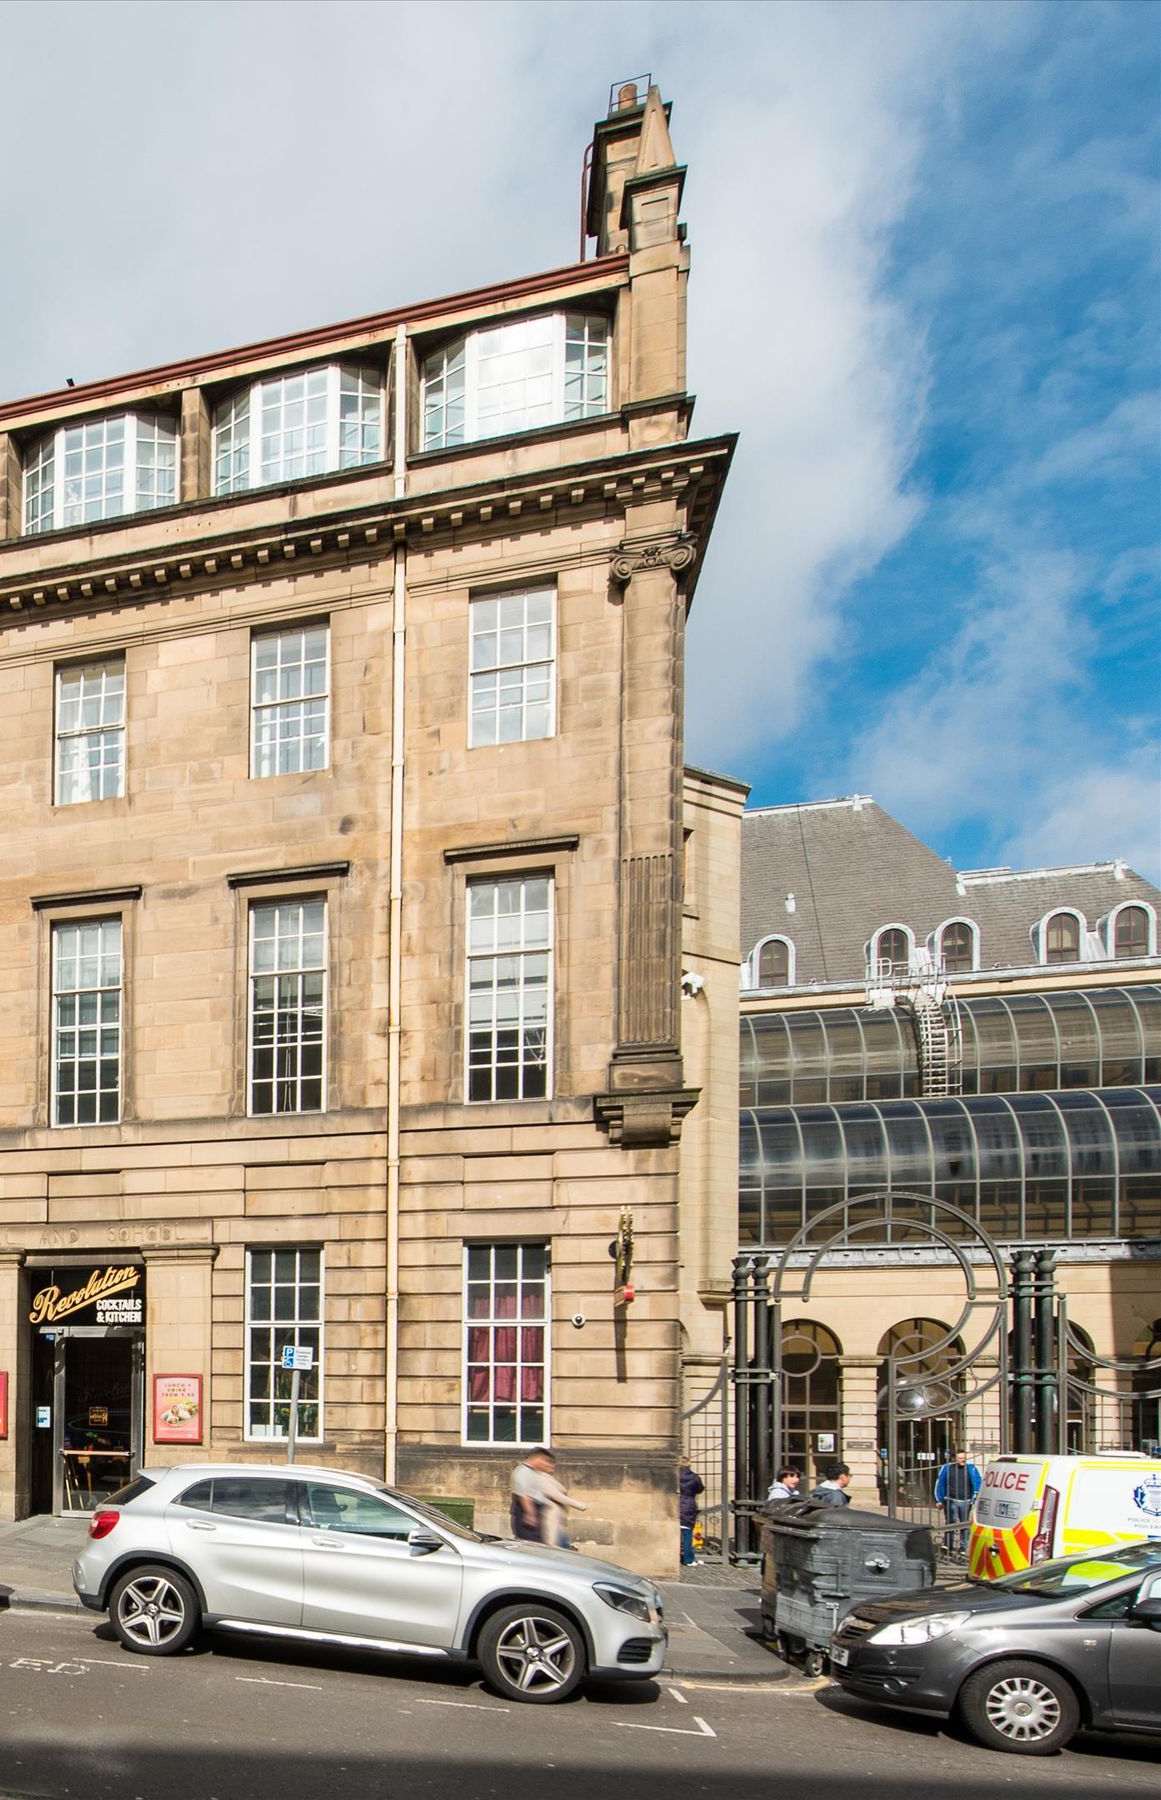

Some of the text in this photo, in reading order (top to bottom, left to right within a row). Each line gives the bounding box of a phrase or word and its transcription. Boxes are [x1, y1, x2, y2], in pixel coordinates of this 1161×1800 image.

[39, 1227, 80, 1245] AND
[106, 1223, 185, 1243] SCHOOL
[29, 1266, 139, 1323] Revolution
[96, 1299, 142, 1311] COCKTAILS
[96, 1311, 142, 1323] & KITCHEN
